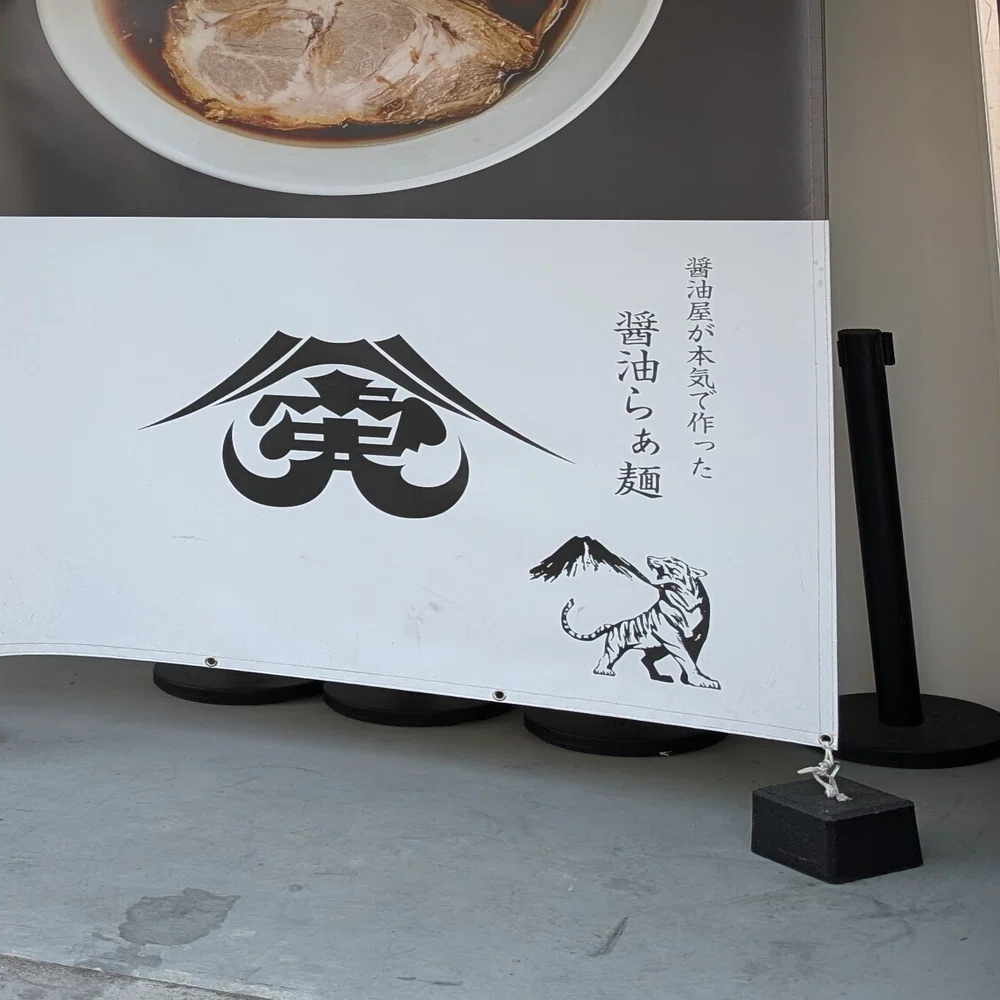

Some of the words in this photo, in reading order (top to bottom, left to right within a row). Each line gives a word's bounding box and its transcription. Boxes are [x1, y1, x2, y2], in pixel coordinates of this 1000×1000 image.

[685, 256, 717, 479] 醤油屋が本気で作った
